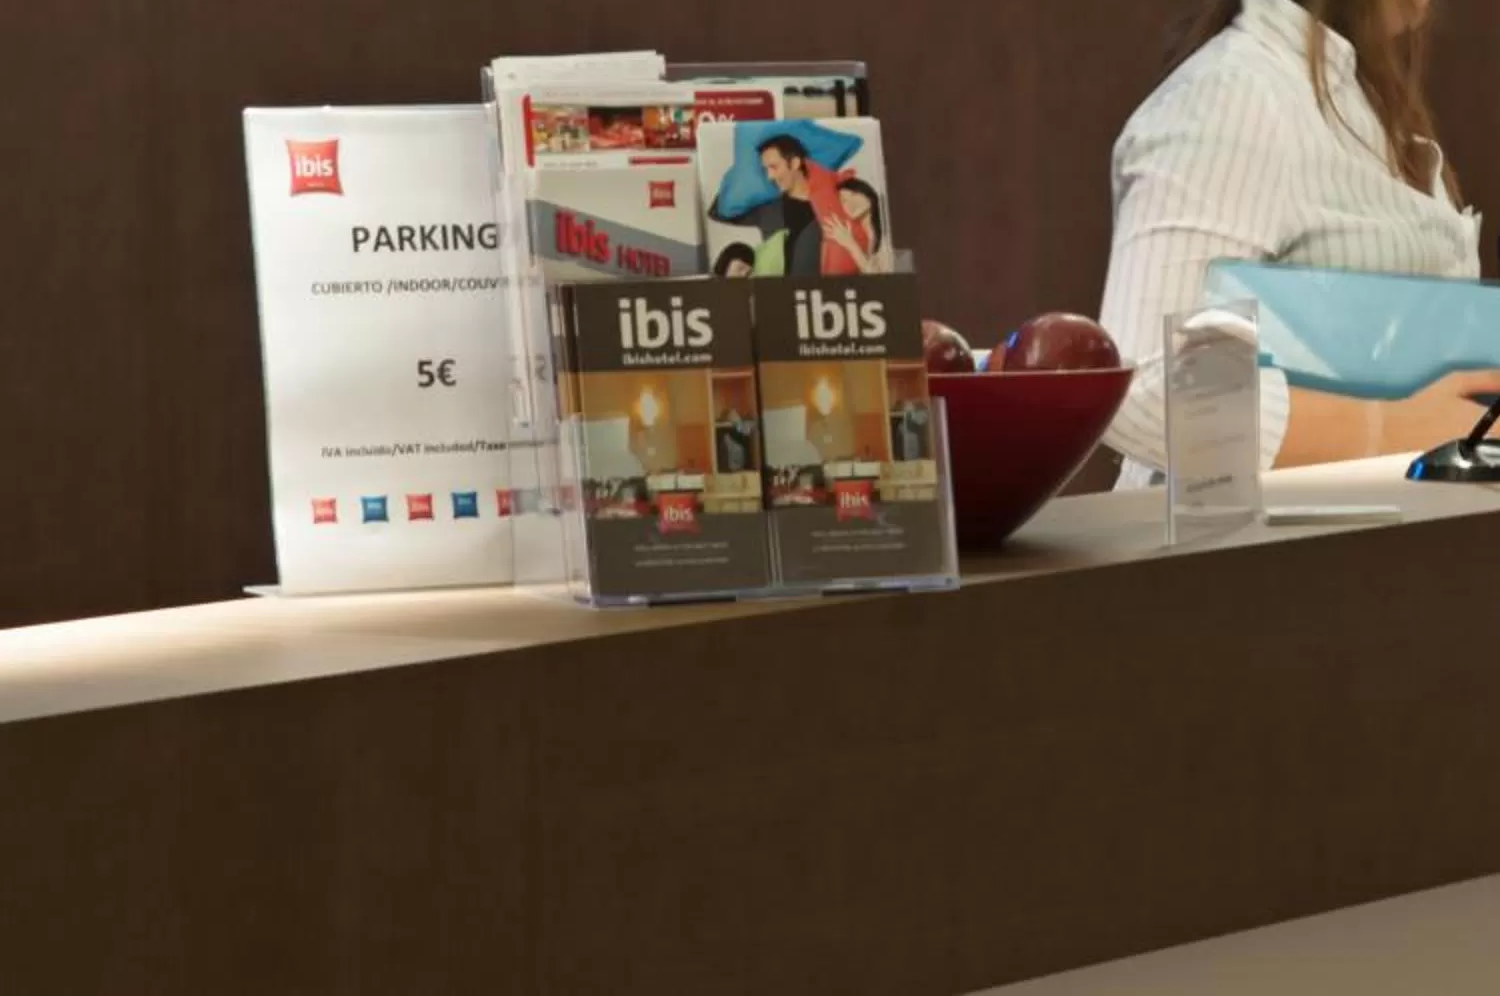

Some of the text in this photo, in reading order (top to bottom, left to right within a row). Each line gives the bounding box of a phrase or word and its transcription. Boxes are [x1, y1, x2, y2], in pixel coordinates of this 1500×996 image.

[296, 155, 333, 177] ibis
[351, 222, 499, 253] PARKING
[555, 210, 611, 264] ibis
[310, 280, 383, 295] CUBIERTO
[618, 295, 714, 349] ibis
[794, 288, 887, 340] ibis
[622, 351, 712, 366] ibishotel.com
[799, 342, 886, 357] ibishotel.com
[417, 358, 457, 388] 5€
[321, 446, 342, 458] IVA
[662, 504, 695, 522] ibis
